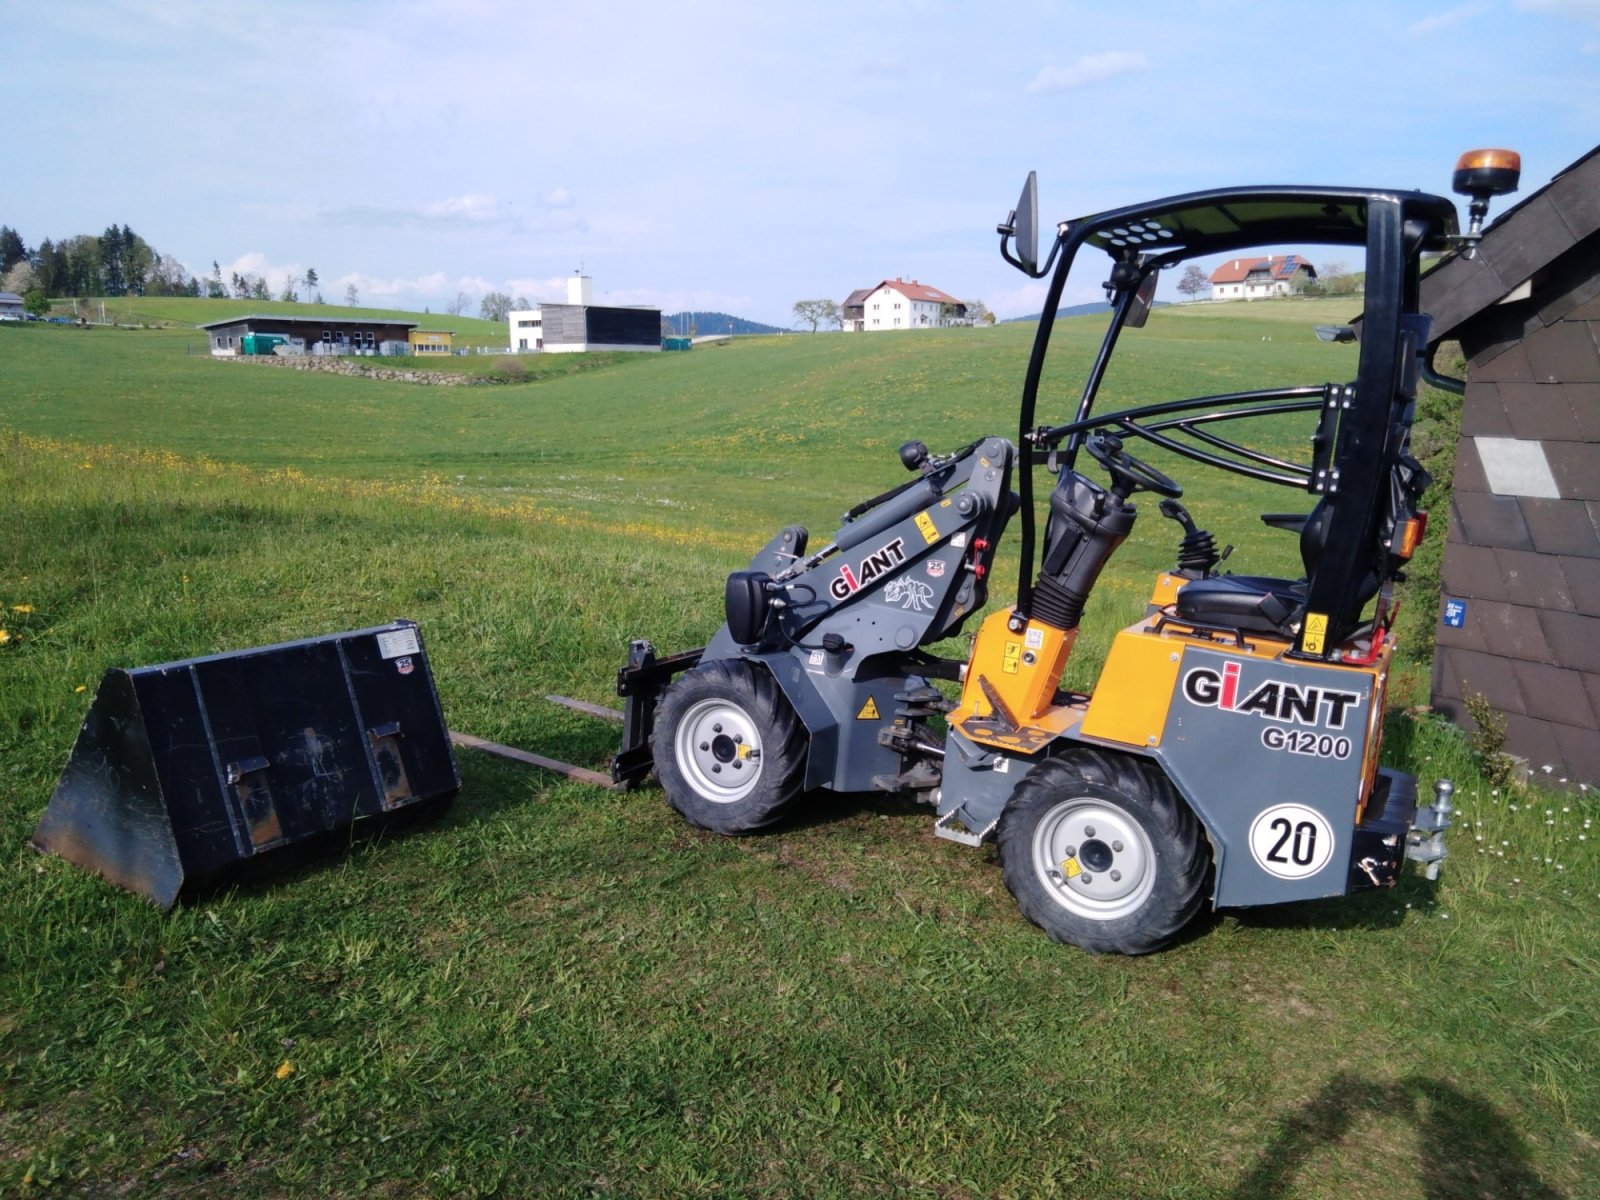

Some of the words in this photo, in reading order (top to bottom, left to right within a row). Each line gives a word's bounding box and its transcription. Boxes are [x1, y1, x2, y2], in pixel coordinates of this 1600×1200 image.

[930, 563, 943, 571] 25
[399, 659, 411, 668] 25
[1262, 728, 1351, 760] G1200
[1267, 818, 1318, 866] 20
